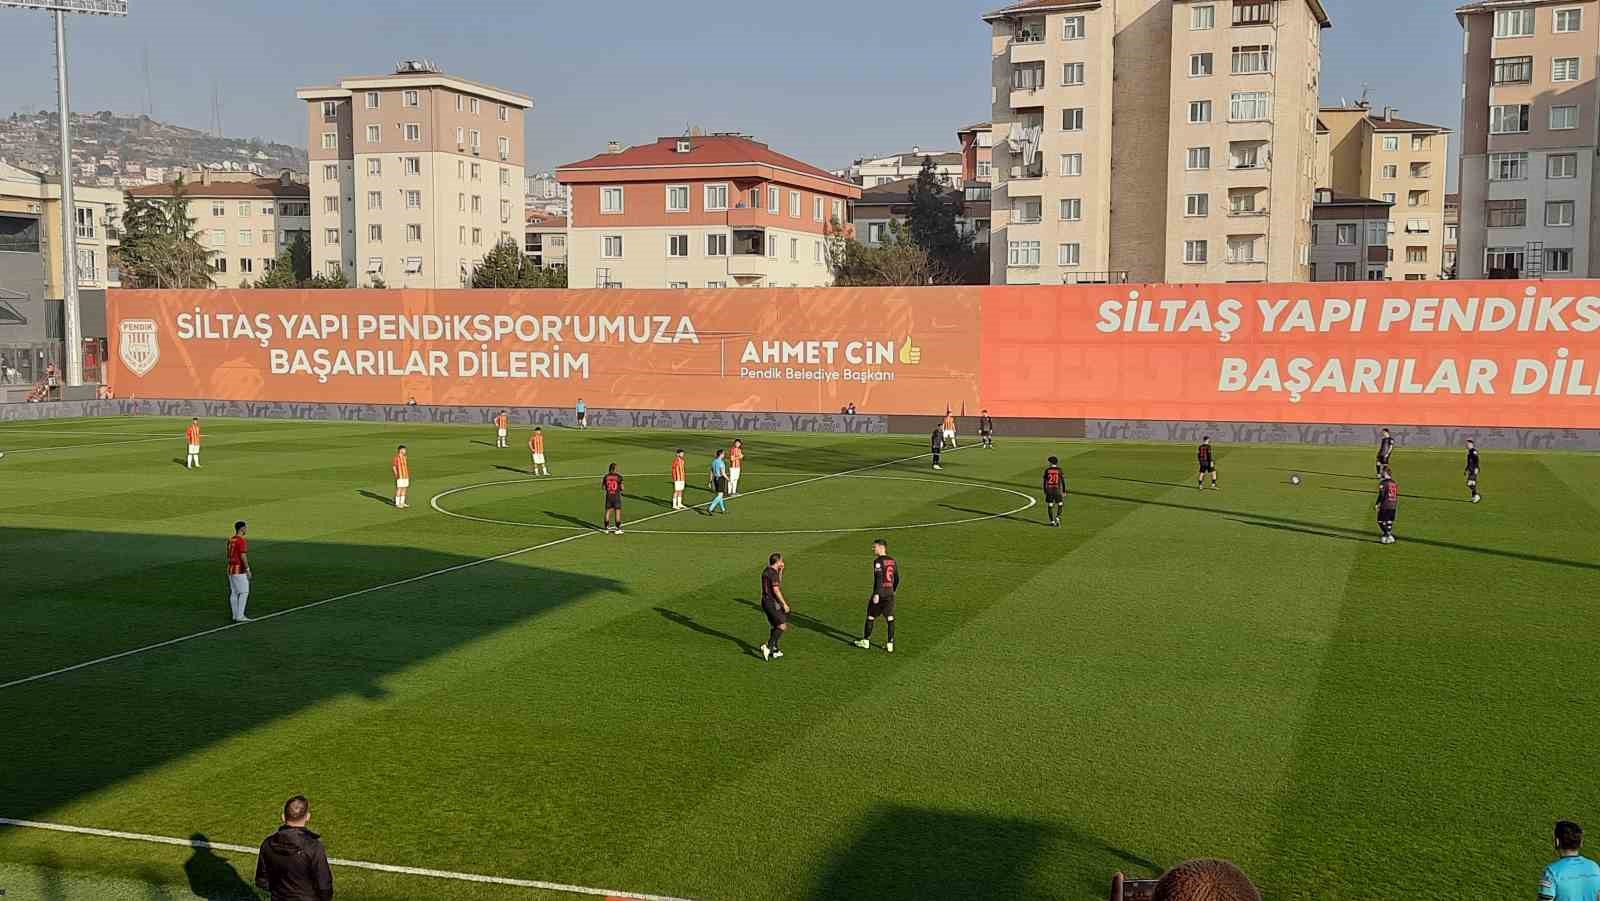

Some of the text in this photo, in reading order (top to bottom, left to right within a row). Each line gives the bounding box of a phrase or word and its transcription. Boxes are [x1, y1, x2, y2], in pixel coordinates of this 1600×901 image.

[176, 306, 273, 349] SİLTAŞ
[277, 314, 348, 340] YAPI
[1095, 289, 1243, 342] SİLTAŞ
[1256, 298, 1367, 332] YAPI
[270, 345, 589, 384] BAŞARILAR DİLERİM
[740, 340, 839, 364] AHMET
[740, 367, 895, 384] Pendik Belediye Başkanı
[1217, 347, 1600, 403] BAŞARILAR DİL
